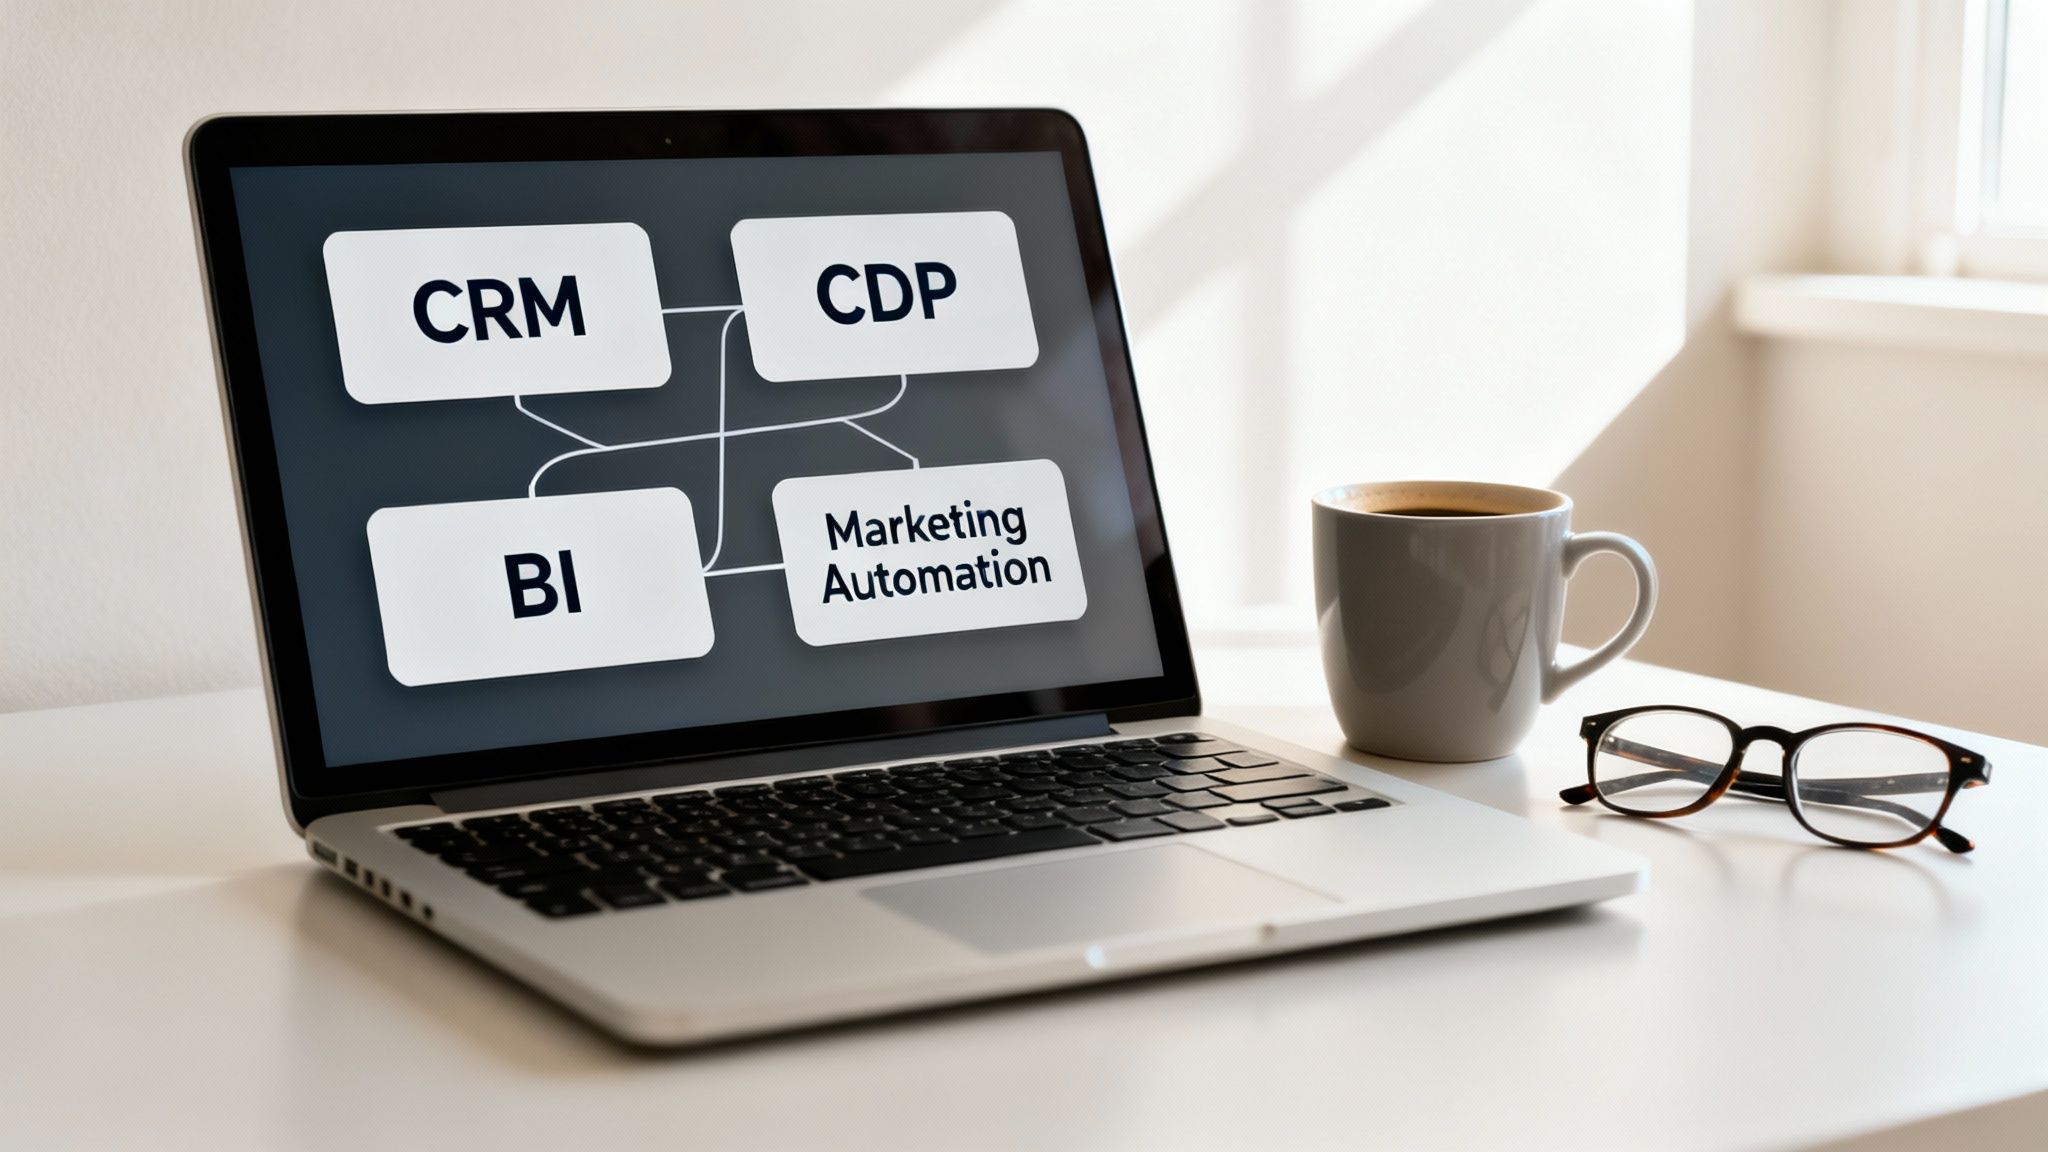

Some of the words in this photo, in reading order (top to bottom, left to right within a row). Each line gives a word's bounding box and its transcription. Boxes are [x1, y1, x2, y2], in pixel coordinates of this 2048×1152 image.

[412, 274, 587, 344] CRM
[816, 261, 957, 326] CDP
[825, 499, 1028, 551] Marketing
[503, 549, 582, 620] BI
[822, 548, 1053, 604] Automation
